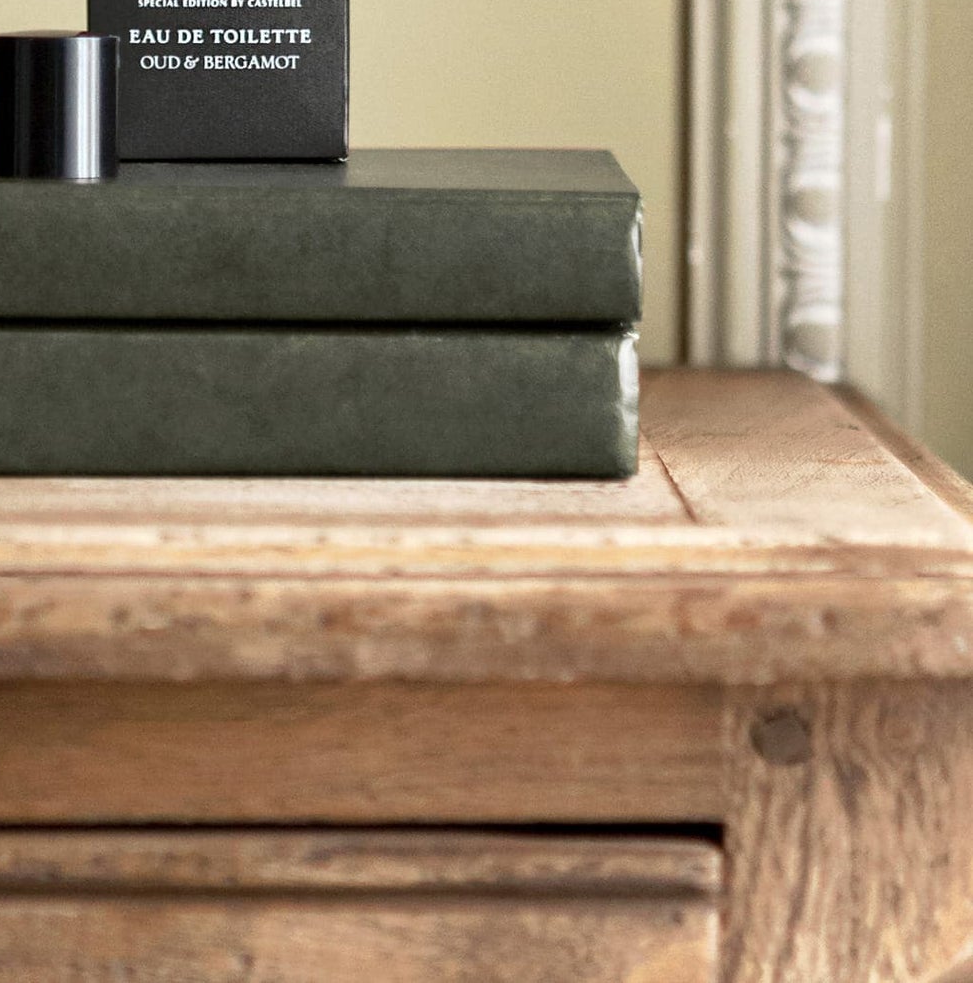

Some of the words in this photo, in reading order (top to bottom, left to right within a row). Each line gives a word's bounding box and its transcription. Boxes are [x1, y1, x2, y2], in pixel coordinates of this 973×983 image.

[138, 0, 179, 8] SPECIAL
[183, 0, 227, 8] EDITION
[231, 0, 244, 8] BY
[248, 0, 302, 8] CASTELBEL
[129, 30, 170, 44] EAU
[178, 30, 203, 44] DE
[210, 30, 312, 44] TOILETTE
[140, 55, 180, 69] OUD
[184, 56, 199, 69] &
[204, 55, 300, 70] BERGAMOT
